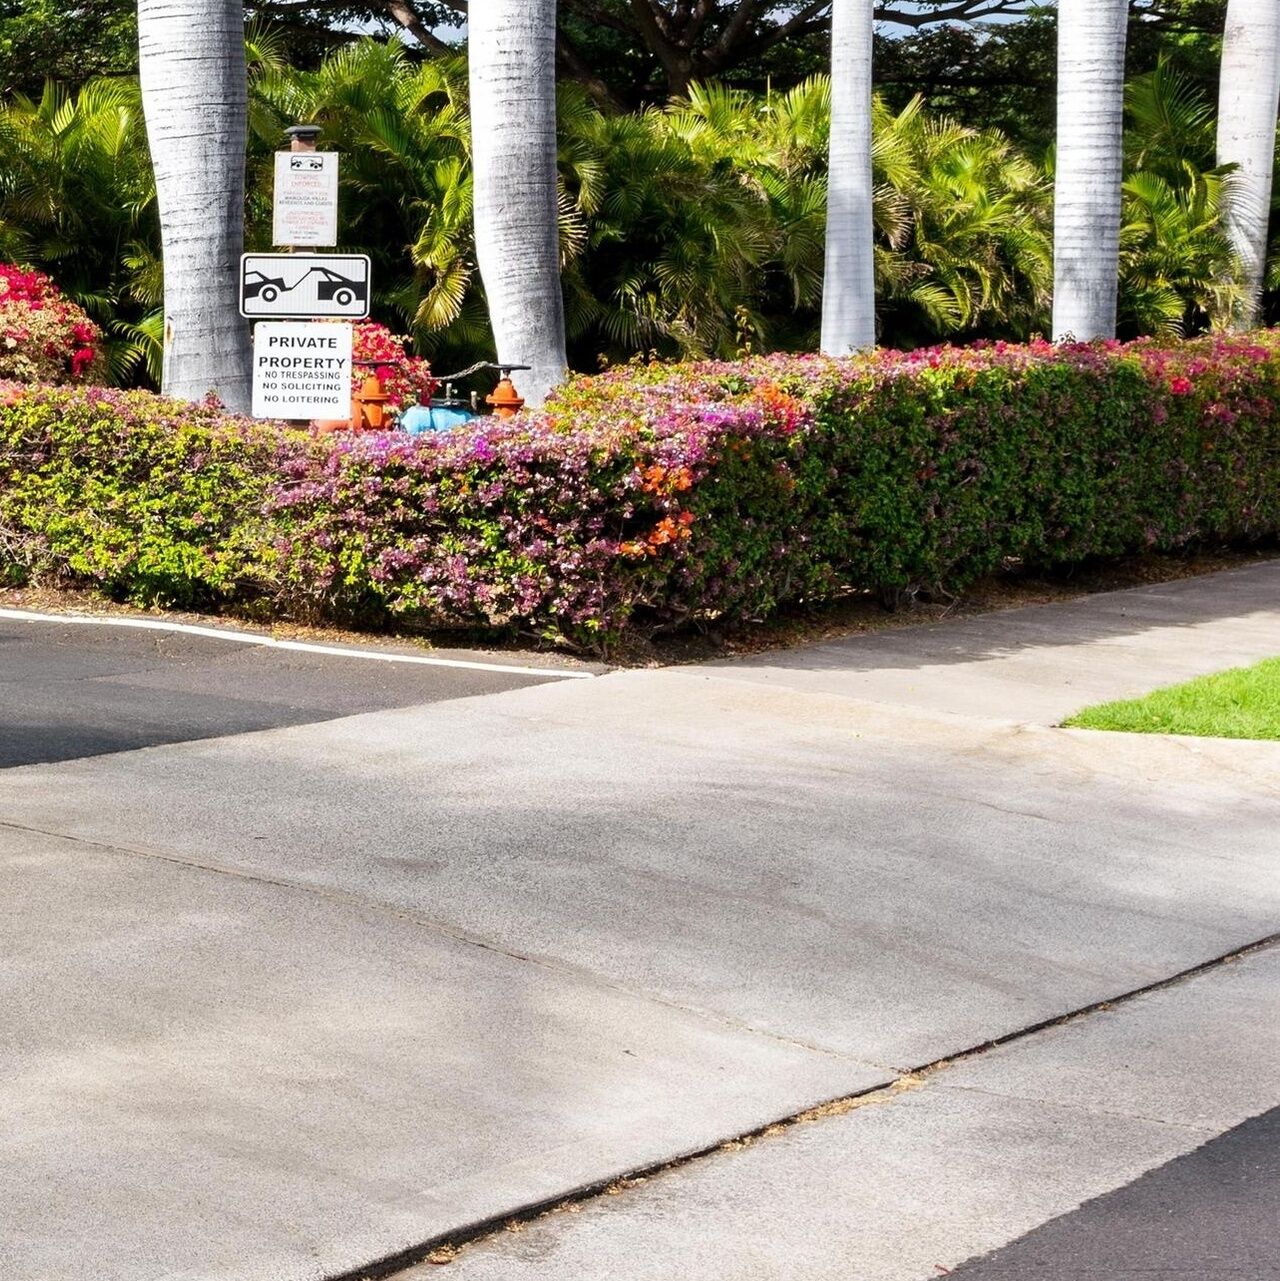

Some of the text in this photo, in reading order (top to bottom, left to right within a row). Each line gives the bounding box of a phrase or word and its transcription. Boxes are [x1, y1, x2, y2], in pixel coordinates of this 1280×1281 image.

[269, 336, 337, 349] PRIVATE
[258, 356, 346, 369] PROPERTY
[264, 370, 341, 380] NO TRESPASSING
[262, 382, 341, 391] NO SOLICITING
[282, 395, 339, 404] LOITERING
